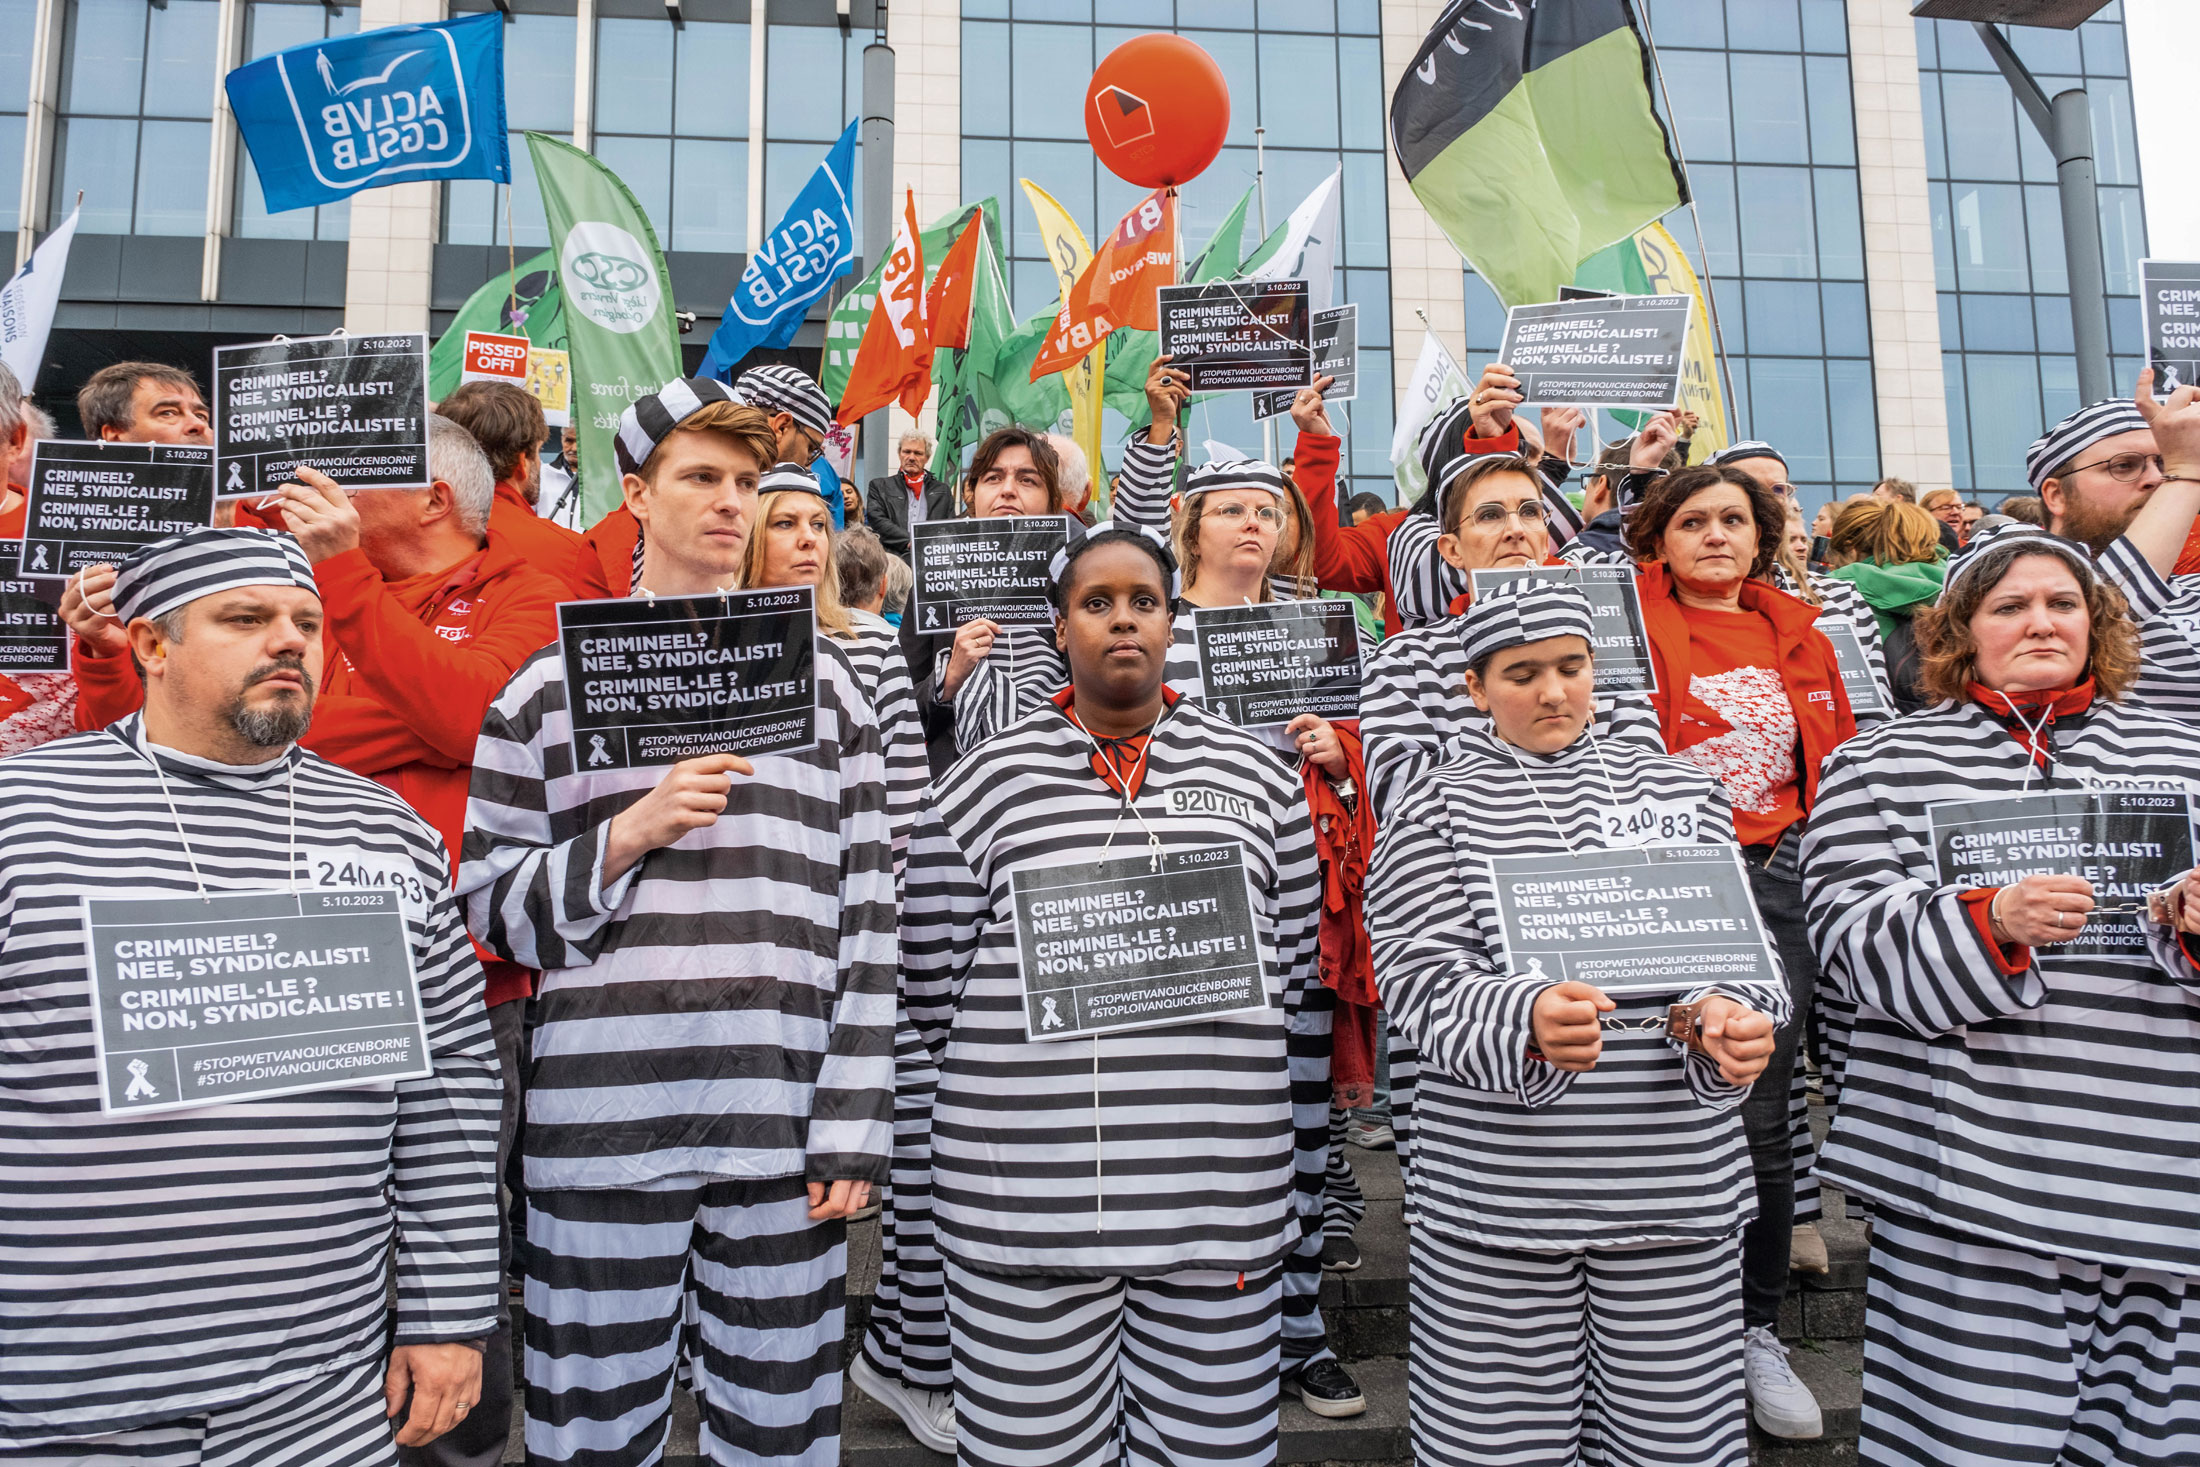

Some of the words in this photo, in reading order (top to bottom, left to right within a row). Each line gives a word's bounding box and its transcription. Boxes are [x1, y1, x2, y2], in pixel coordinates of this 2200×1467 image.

[1268, 283, 1301, 291] 5.10.2023
[1170, 306, 1244, 319] CRIMINEEL?
[2160, 304, 2199, 317] NEE,
[1170, 319, 1199, 330] NEE,
[1202, 314, 1289, 328] SYNDICALIST!
[1518, 320, 1605, 333] CRIMINEEL?
[1254, 331, 1261, 340] ?
[1516, 332, 1548, 343] NEE,
[1552, 328, 1658, 340] SYNDICALIST!
[363, 340, 412, 349] 5.10.2023
[469, 341, 525, 360] PISSED
[1170, 345, 1202, 355] NON,
[1206, 340, 1297, 353] SYNDICALISTE
[1612, 343, 1620, 353] ?
[478, 356, 514, 372] OFF!
[1511, 355, 1547, 366] NON,
[1551, 355, 1663, 365] SYNDICALISTE
[1666, 355, 1672, 364] !
[1200, 367, 1304, 377] #STOPWETVANQUICKENBORNE
[1200, 375, 1302, 384] #STOPLOIVANQUICKENBORNE
[229, 370, 328, 392] CRIMINEEL?
[230, 393, 267, 408] NEE,
[271, 382, 393, 402] SYNDICALIST!
[343, 405, 351, 418] ?
[229, 428, 271, 443] NON,
[275, 418, 405, 437] SYNDICALISTE
[411, 418, 416, 430] !
[166, 450, 208, 459] 5.10.2023
[45, 470, 134, 484] CRIMINEEL?
[43, 484, 78, 498] NEE,
[82, 485, 187, 500] SYNDICALIST!
[141, 506, 149, 517] ?
[39, 516, 78, 531] NON,
[82, 518, 193, 533] SYNDICALISTE
[924, 541, 999, 555] CRIMINEEL?
[924, 556, 953, 566] NEE,
[957, 551, 1047, 564] SYNDICALIST!
[1012, 567, 1018, 576] ?
[926, 582, 958, 592] NON,
[961, 577, 1047, 589] SYNDICALIST
[747, 594, 800, 608] 5.10.2023
[955, 604, 1049, 614] #STOPWETVANQUICKENBO
[580, 633, 708, 654] CRIMINEEL?
[1208, 629, 1288, 644] CRIMINEEL?
[1209, 645, 1241, 657] NEE,
[1245, 637, 1338, 654] SYNDICALIST!
[582, 655, 632, 673] NEE,
[637, 643, 782, 669] SYNDICALIST!
[1303, 656, 1310, 666] ?
[729, 672, 738, 686] ?
[1213, 674, 1249, 686] NON,
[1253, 666, 1349, 682] SYNDICALISTE
[1352, 665, 1356, 675] !
[586, 697, 641, 713] NON,
[647, 681, 795, 710] SYNDICALISTE
[800, 679, 806, 693] !
[1248, 695, 1359, 709] #STOPWETVANQUICKENBORNE
[1251, 703, 1358, 717] #STOPLOIVANQUICKENBORNE
[638, 718, 806, 746] #STOPWETVANQUICKENBORNE
[641, 730, 802, 757] #STOPLOIVANQUICKENBORNE
[1172, 790, 1251, 821] 920701
[2120, 797, 2175, 807] 5.10.2023
[1607, 808, 1692, 838] 24083
[1950, 826, 2080, 850] CRIMINEEL?
[1179, 850, 1229, 865] 5.10.2023
[1666, 849, 1720, 858] 5.10.2023
[1952, 849, 2001, 866] NEE,
[2007, 843, 2161, 861] SYNDICALIST!
[2104, 865, 2116, 879] ?
[1512, 876, 1632, 895] CRIMINEEL?
[322, 896, 384, 907] 5.10.2023
[1030, 890, 1145, 917] CRIMINEEL?
[1514, 895, 1562, 909] NEE,
[1566, 885, 1712, 906] SYNDICALIST!
[1032, 916, 1078, 934] NEE,
[1083, 898, 1218, 928] SYNDICALIST!
[1660, 907, 1668, 919] ?
[1166, 927, 1176, 941] ?
[1521, 926, 1576, 941] NON,
[1580, 919, 1735, 939] SYNDICALISTE
[1740, 919, 1748, 930] !
[114, 933, 277, 958] CRIMINEEL?
[1038, 956, 1088, 975] NON,
[1093, 936, 1235, 969] SYNDICALISTE
[1240, 935, 1246, 949] !
[1576, 953, 1757, 969] #STOPWETVANQUICKENBORNE
[117, 960, 183, 981] NEE,
[190, 947, 370, 976] SYNDICALIST!
[1580, 964, 1756, 979] #STOPLOIVANQUICKENBORNE
[305, 977, 317, 994] ?
[1087, 977, 1252, 1006] #STOPWETVANQUICKENBORNE
[1090, 989, 1250, 1018] #STOPLOIVANQUICKENBORNE
[123, 1010, 197, 1032] NON,
[204, 991, 392, 1024] SYNDICALISTE
[397, 991, 405, 1007] !
[193, 1037, 411, 1072] #STOPWETVANQUICKENBORNE
[197, 1051, 408, 1086] #STOPLOIVANQUICKENBORNE
